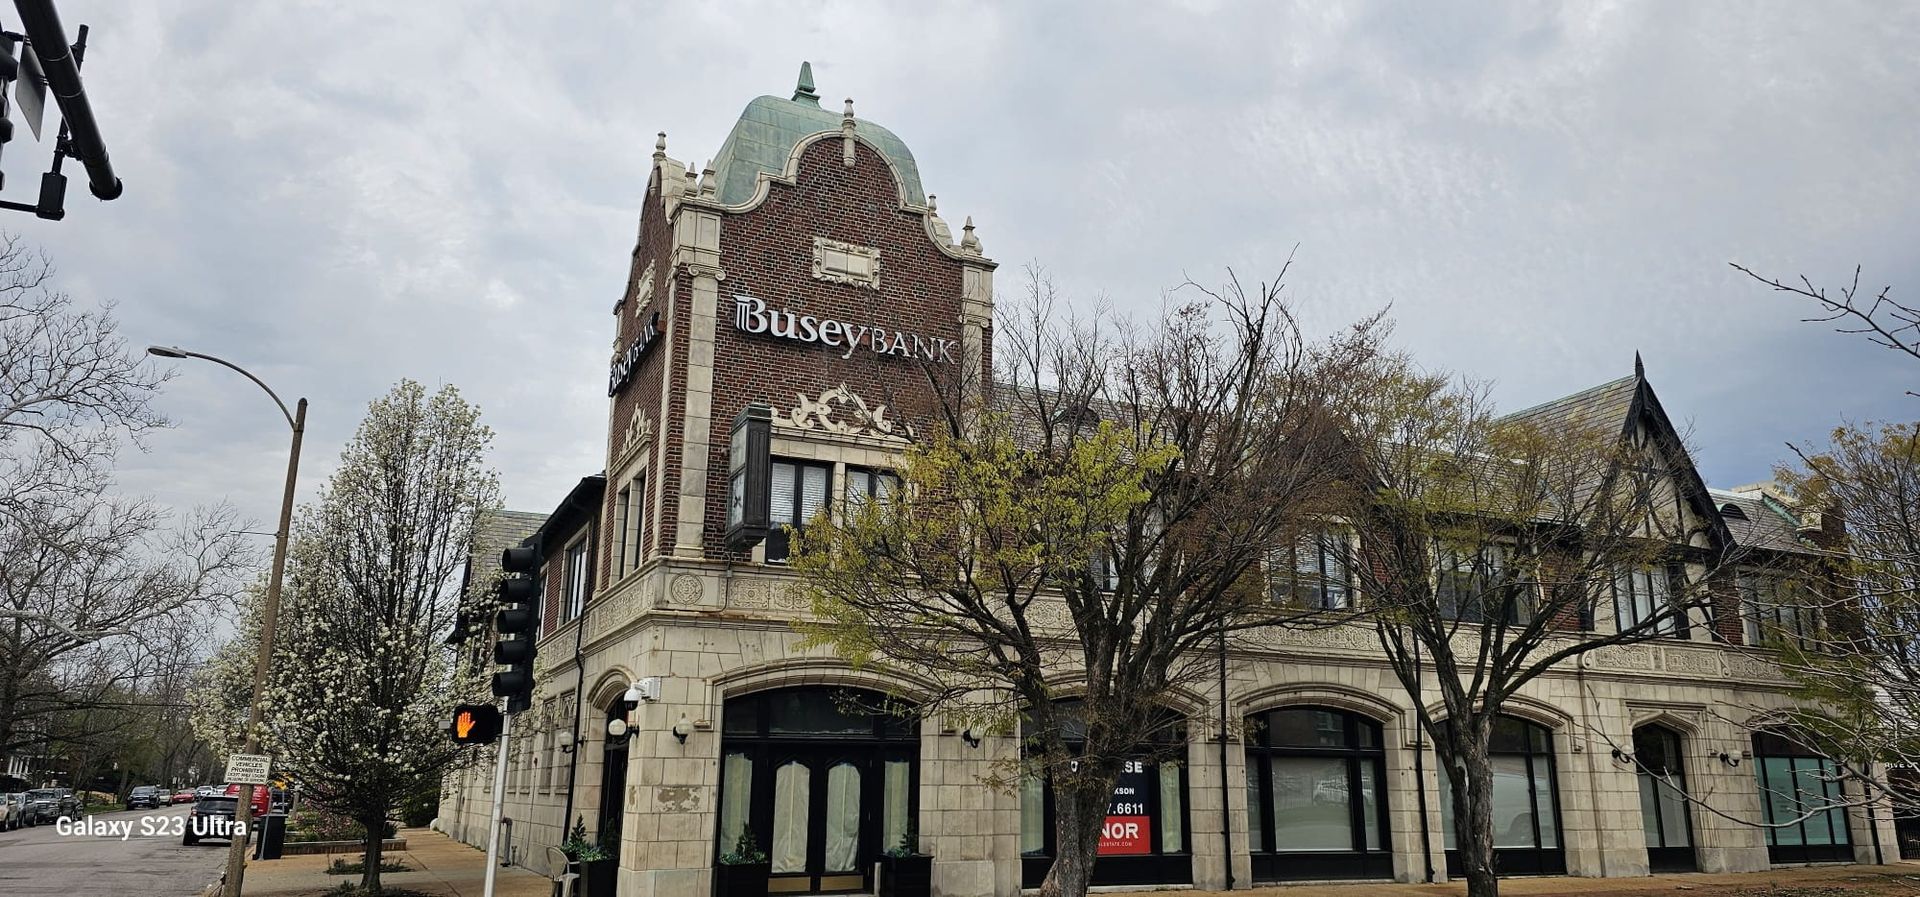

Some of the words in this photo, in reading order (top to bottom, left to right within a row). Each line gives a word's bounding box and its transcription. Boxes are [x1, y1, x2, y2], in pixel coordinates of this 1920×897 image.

[732, 295, 873, 360] Busey
[870, 325, 957, 365] BANK
[231, 766, 265, 774] PROHIBITED
